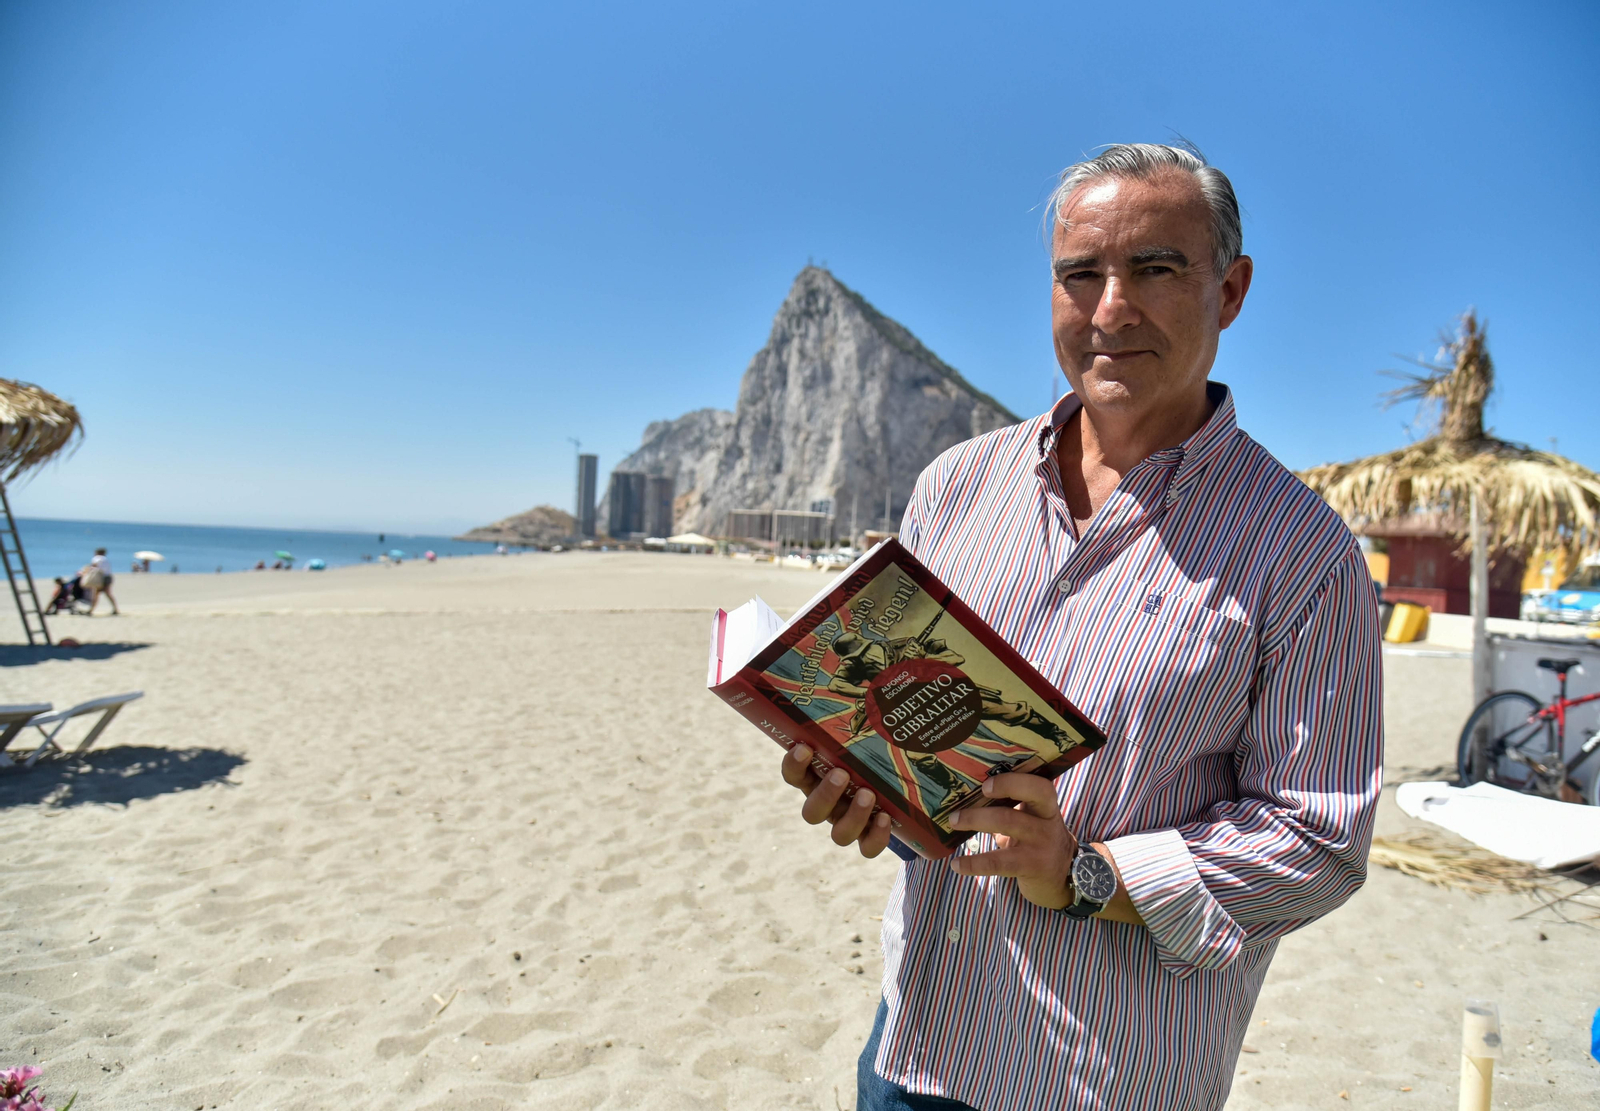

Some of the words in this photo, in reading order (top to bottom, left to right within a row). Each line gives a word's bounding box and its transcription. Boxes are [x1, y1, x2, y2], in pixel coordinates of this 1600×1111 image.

[847, 597, 875, 632] wird
[881, 671, 909, 693] ALFONSO
[885, 675, 917, 699] ESCUADRA
[883, 674, 952, 726] OBJETIVO
[893, 683, 974, 741] GIBRALTAR
[918, 728, 934, 741] Entre
